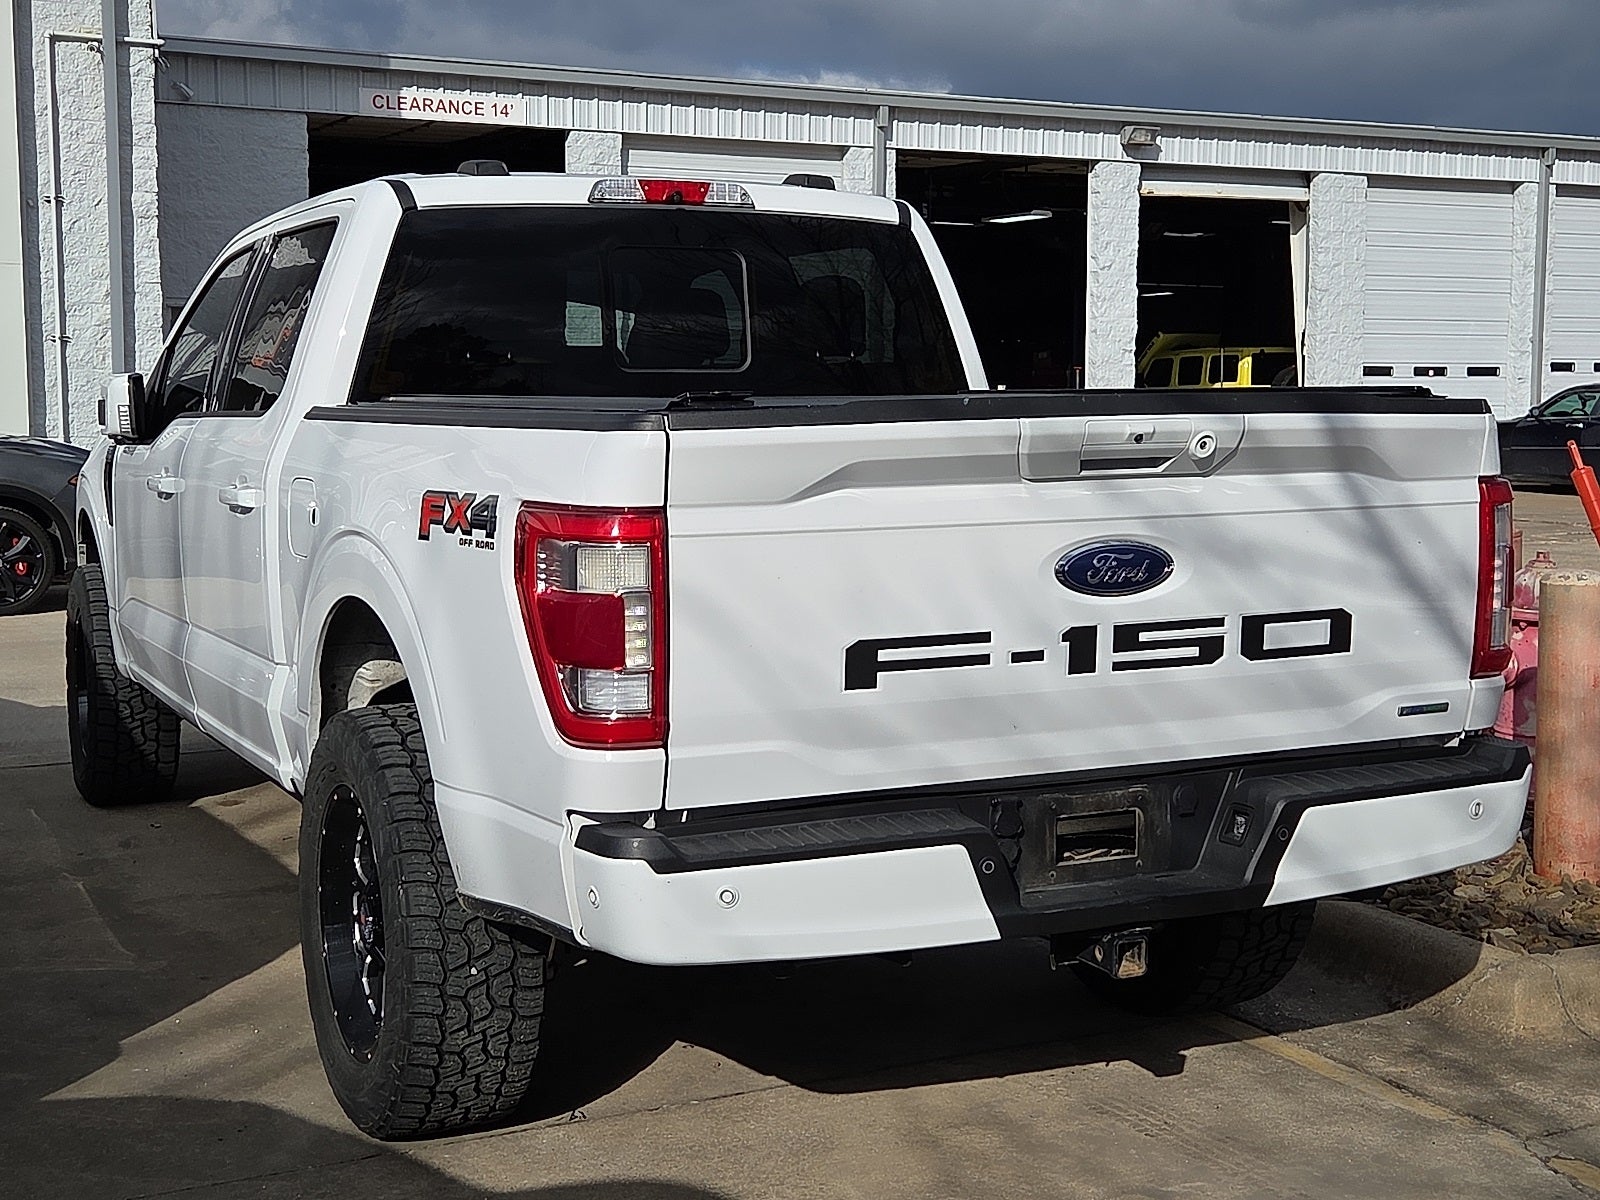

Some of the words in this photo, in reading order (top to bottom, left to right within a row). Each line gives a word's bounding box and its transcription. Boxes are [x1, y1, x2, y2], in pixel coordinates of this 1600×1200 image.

[372, 94, 485, 117] CLEARANCE
[418, 489, 499, 541] FX4
[459, 537, 474, 547] OFF
[475, 540, 495, 550] ROAD
[1087, 553, 1150, 584] Ford
[844, 607, 1353, 691] F-150
